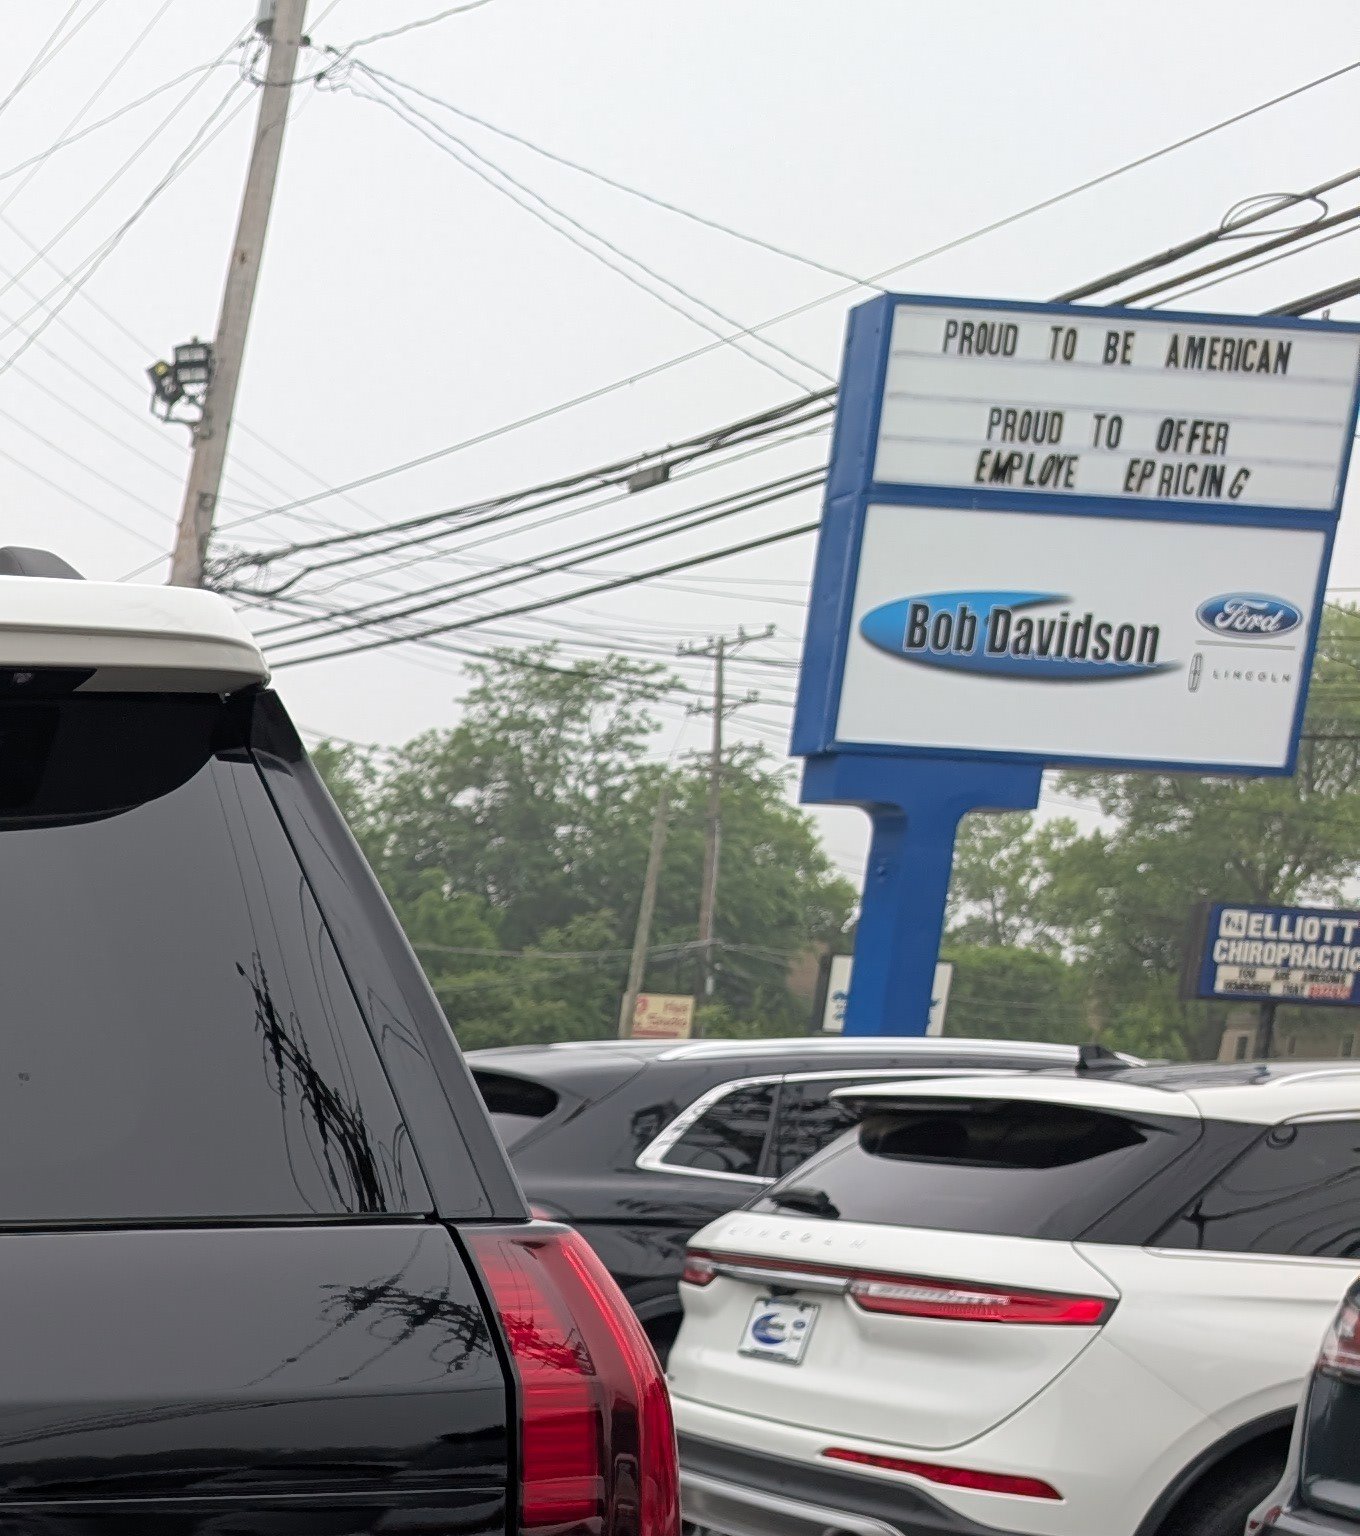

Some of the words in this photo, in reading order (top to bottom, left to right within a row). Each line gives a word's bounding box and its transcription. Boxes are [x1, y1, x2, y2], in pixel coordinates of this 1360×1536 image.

[943, 319, 1018, 357] PROUD
[1050, 326, 1077, 361] TO
[1103, 330, 1136, 365] BE
[1165, 334, 1292, 374] AMERICAN
[986, 407, 1065, 444] PROUD
[1093, 414, 1123, 449] TO
[1155, 418, 1229, 456] OFFER
[975, 449, 1078, 489] EMPLOYE
[904, 602, 978, 654] Bob
[987, 608, 1160, 664] Davidson
[1215, 600, 1281, 630] Ford
[1213, 669, 1291, 683] LINCOLN
[1248, 913, 1358, 944] ELLIOTT
[1213, 939, 1360, 971] CHIROPRACTIC
